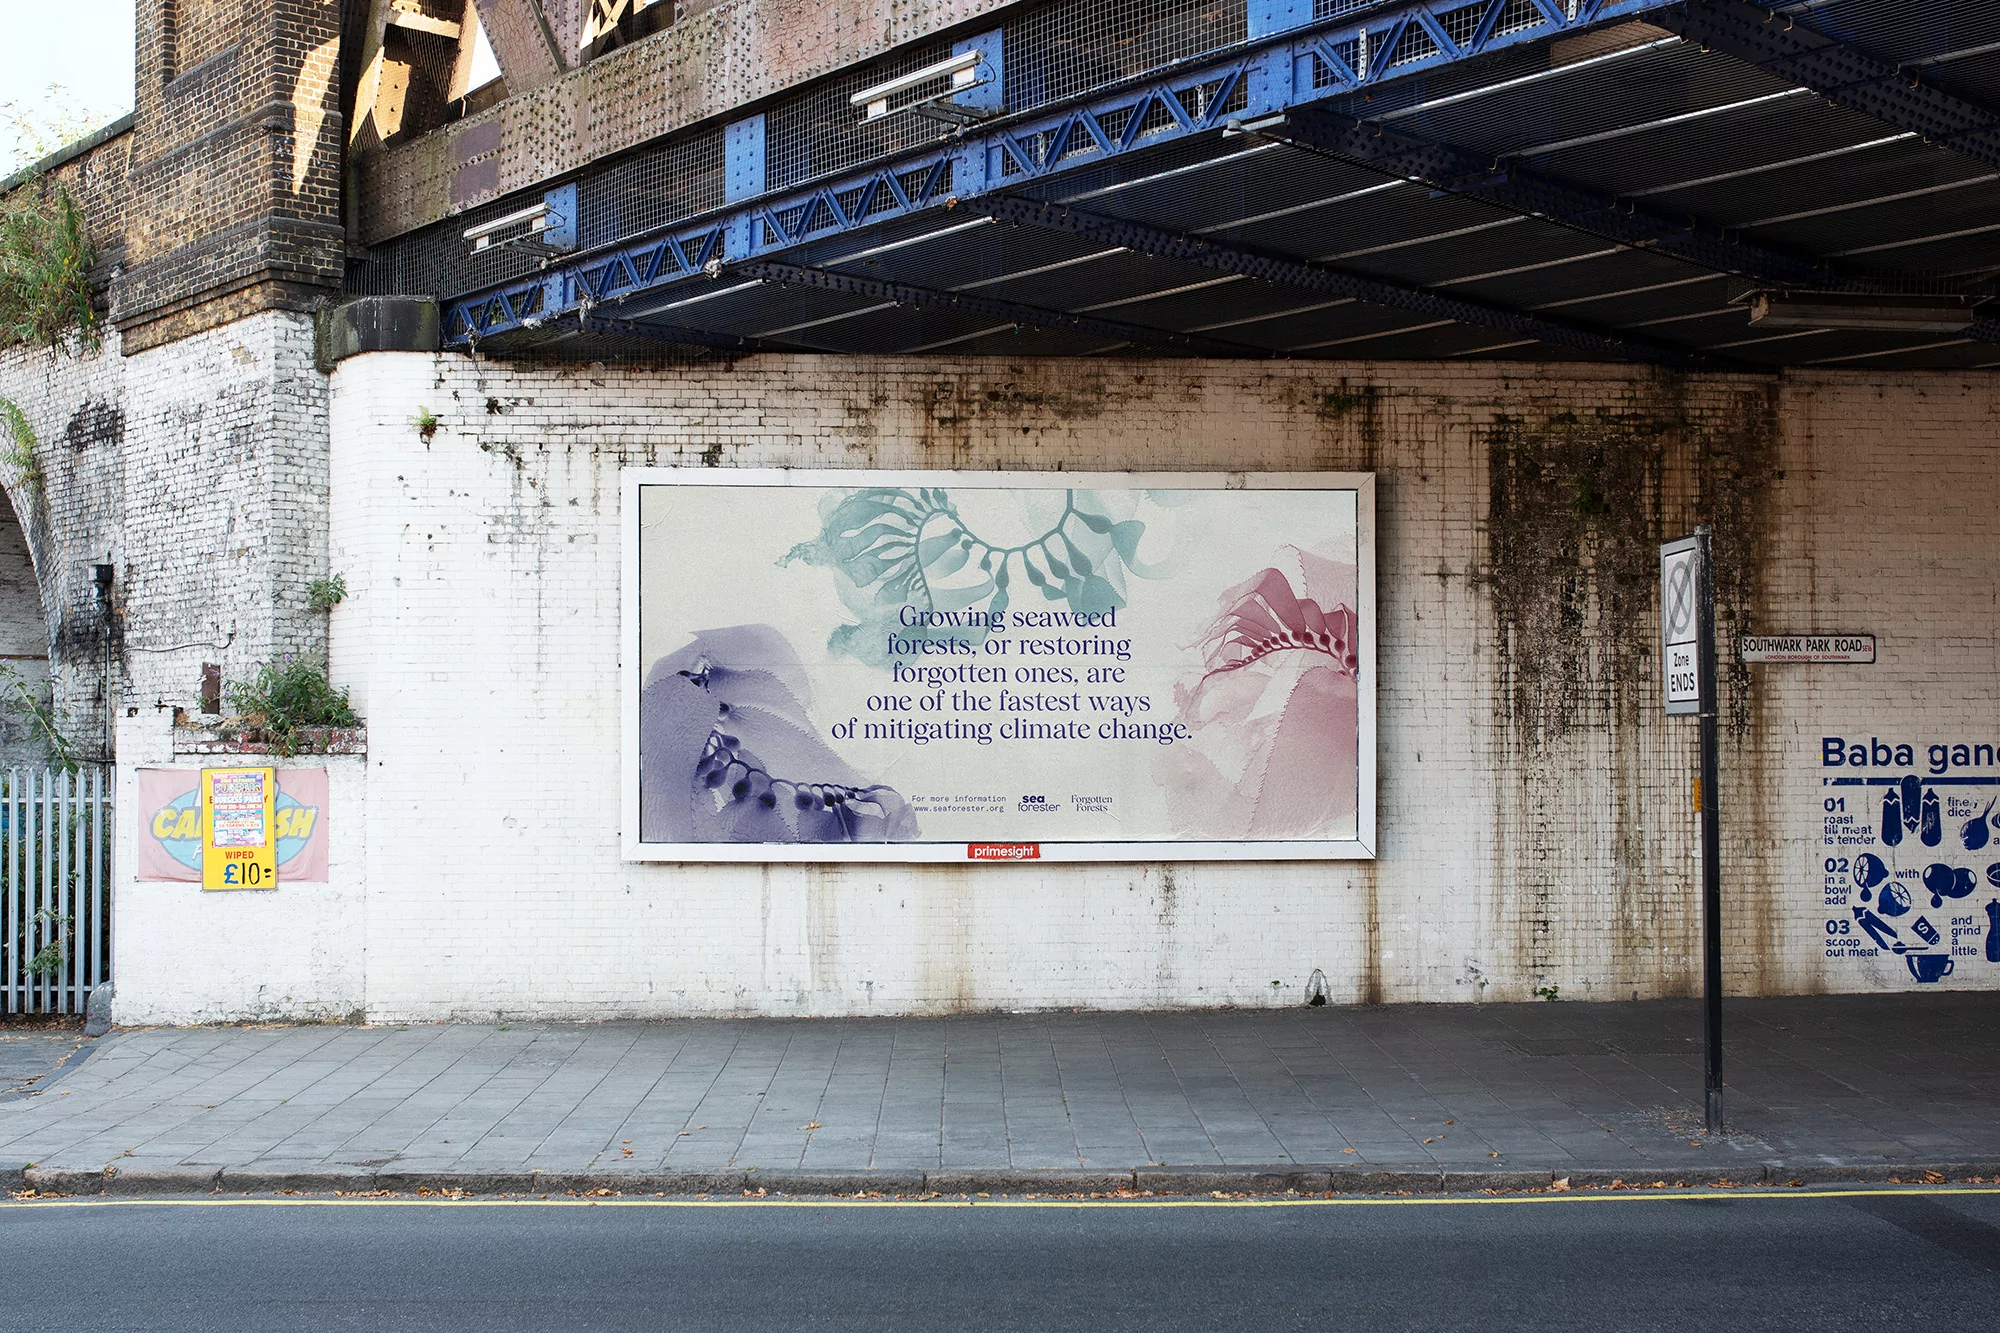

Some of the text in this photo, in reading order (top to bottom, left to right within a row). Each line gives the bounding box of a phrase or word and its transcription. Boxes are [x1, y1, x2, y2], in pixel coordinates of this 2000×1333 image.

[900, 605, 1116, 633] Growing seaweed
[887, 633, 1132, 661] forests, or restoring
[1743, 639, 1873, 652] SOUTHWARK PARK ROAD SE16
[1673, 652, 1690, 668] Zone
[893, 661, 1126, 689] forgotten ones, are
[1671, 671, 1695, 693] ENDS
[866, 689, 1151, 717] one of the fastest ways
[831, 717, 1193, 745] of mitigating climate change.
[1822, 737, 1914, 767] Baba
[911, 794, 1007, 803] For more information
[1022, 795, 1046, 804] sea
[1071, 794, 1113, 805] Forgotten
[913, 804, 1005, 814] www.seaforester.org
[1017, 802, 1061, 812] forester
[1076, 803, 1109, 812] Forests
[1823, 797, 1845, 813] 01
[1947, 808, 1972, 817] dice
[1824, 815, 1854, 825] roast
[1824, 824, 1873, 835] till meat
[1824, 834, 1877, 845] is tender
[225, 851, 254, 859] WIPED
[974, 846, 1035, 859] primesight
[1824, 857, 1849, 873] 02
[1894, 868, 1920, 879] with
[1824, 874, 1846, 885] in a
[1824, 884, 1852, 895] bowl
[1824, 894, 1847, 905] add
[1951, 914, 1973, 926] and
[1825, 919, 1850, 935] 03
[1951, 924, 1981, 938] grind
[1825, 937, 1861, 949] scoop
[1951, 937, 1959, 946] a
[1825, 945, 1879, 957] out meat
[1951, 945, 1978, 956] little
